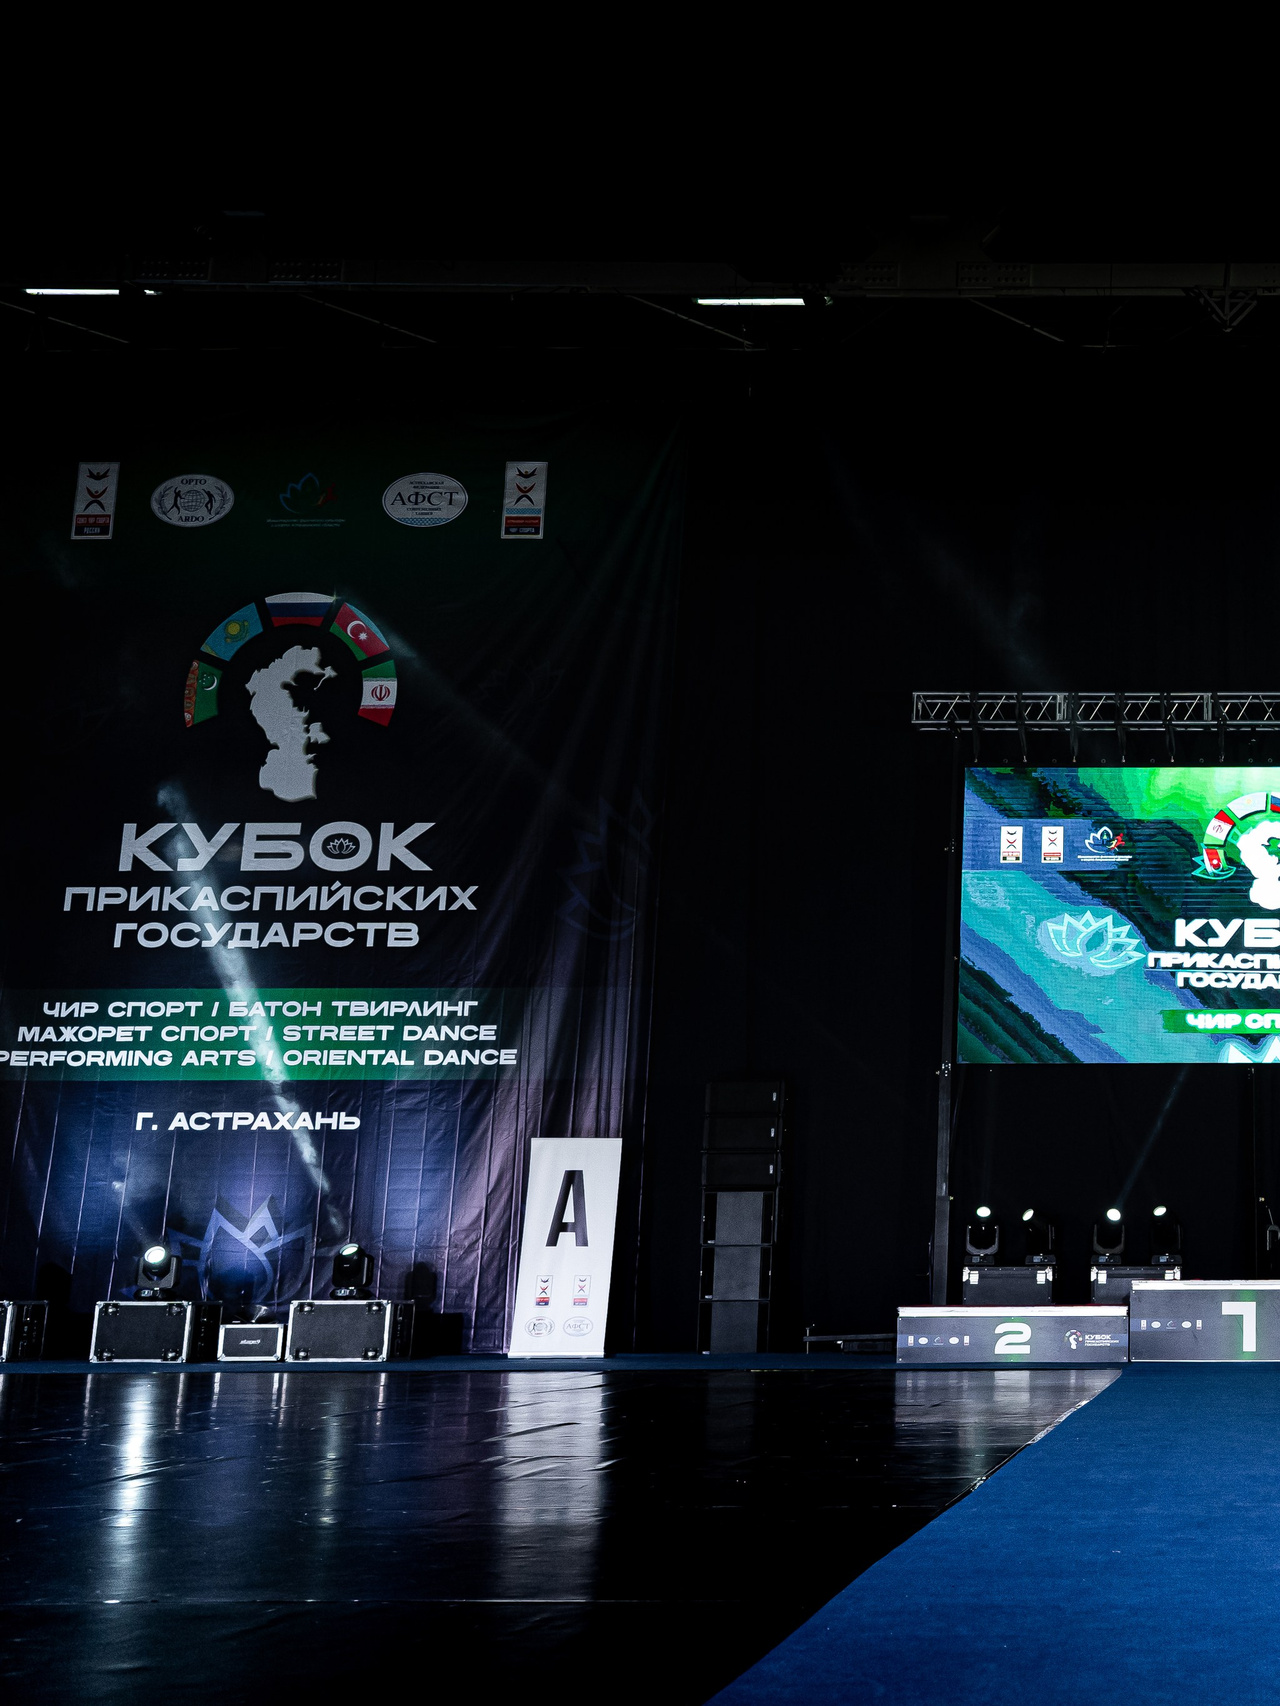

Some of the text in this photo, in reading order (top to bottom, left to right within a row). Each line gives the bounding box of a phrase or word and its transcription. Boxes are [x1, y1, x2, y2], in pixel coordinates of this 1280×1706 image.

[180, 478, 207, 486] ОРТО
[390, 491, 459, 506] АФСТ
[118, 821, 437, 872] КУБОК
[63, 881, 478, 911] ПРИКАСПИЙСКИХ
[113, 922, 420, 949] ГОСУДАРСТВ
[43, 1002, 98, 1017] ЧИР
[107, 1002, 203, 1017] СПОРТ
[228, 1001, 322, 1017] БАТОН
[331, 1000, 477, 1017] ТВИРЛИНГ
[1186, 1013, 1242, 1028] ЧИР
[17, 1026, 152, 1042] МАЖОРЕТ
[160, 1026, 256, 1041] СПОРТ
[282, 1025, 393, 1041] STREET
[401, 1025, 496, 1041] DANCE
[181, 1050, 255, 1066] ARTS
[282, 1049, 413, 1066] ORIENTAL
[422, 1048, 518, 1066] DANCE
[135, 1113, 361, 1131] Г. АСТРАХАНЬ
[545, 1169, 589, 1247] A
[1221, 1301, 1257, 1352] 1
[994, 1322, 1032, 1354] 2
